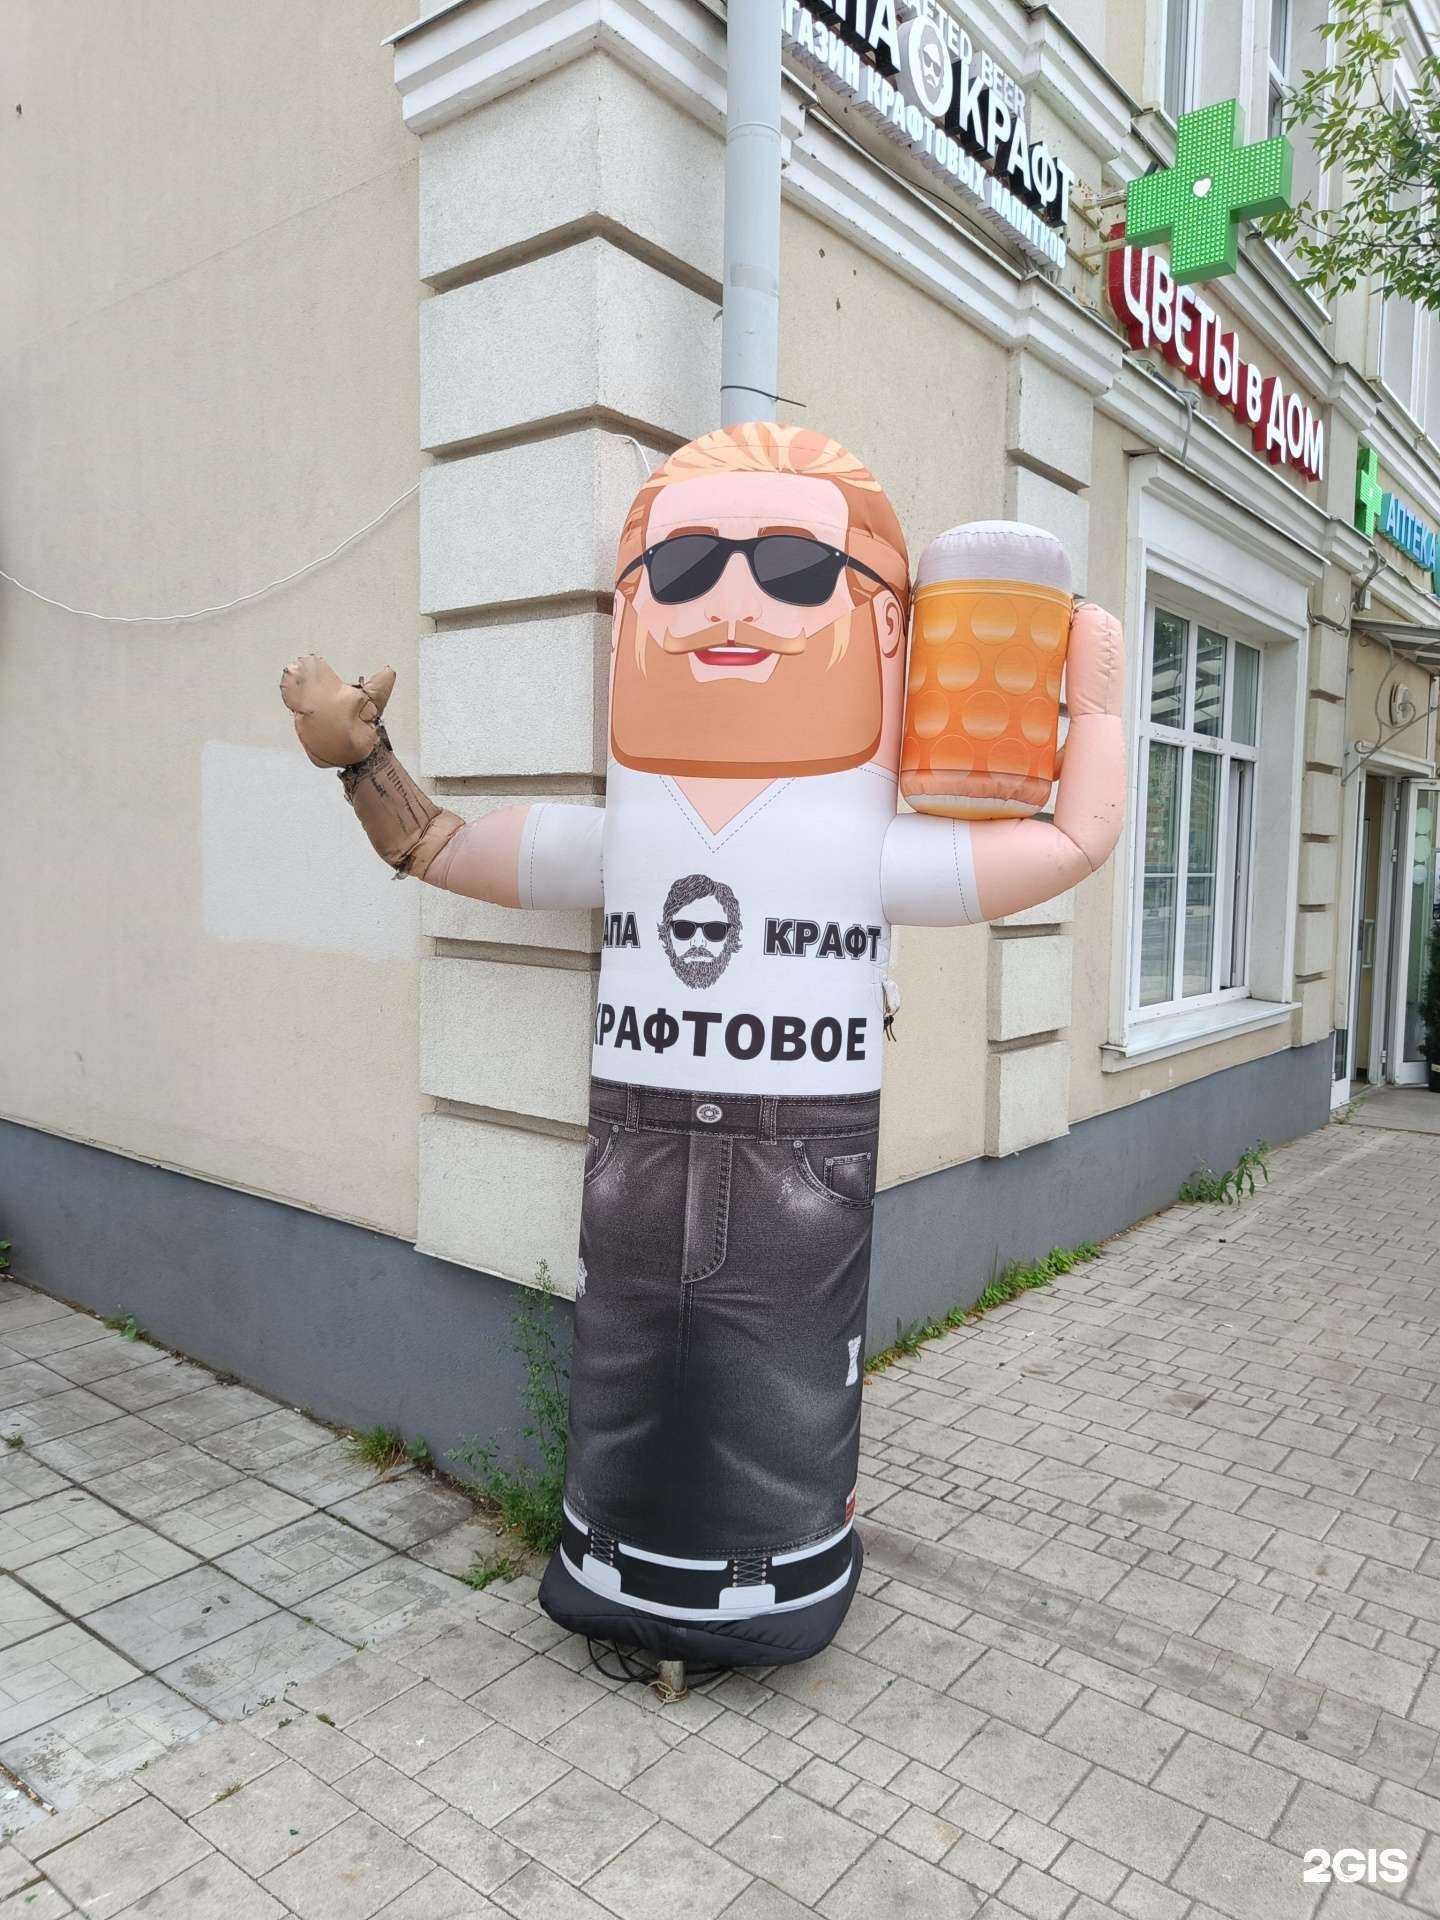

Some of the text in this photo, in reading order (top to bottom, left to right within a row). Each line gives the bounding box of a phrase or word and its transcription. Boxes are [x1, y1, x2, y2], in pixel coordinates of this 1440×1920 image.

[781, 0, 1067, 269] ГАЗИН КРАФТОВЫХ НАПИТКОВ
[959, 62, 1075, 224] КРАФТ
[981, 50, 1025, 118] BEER
[1124, 246, 1240, 405] ЦВЕТЫ
[1267, 376, 1325, 480] ДОМ
[1386, 493, 1437, 569] АПТЕКА
[763, 917, 882, 961] КРАФТ
